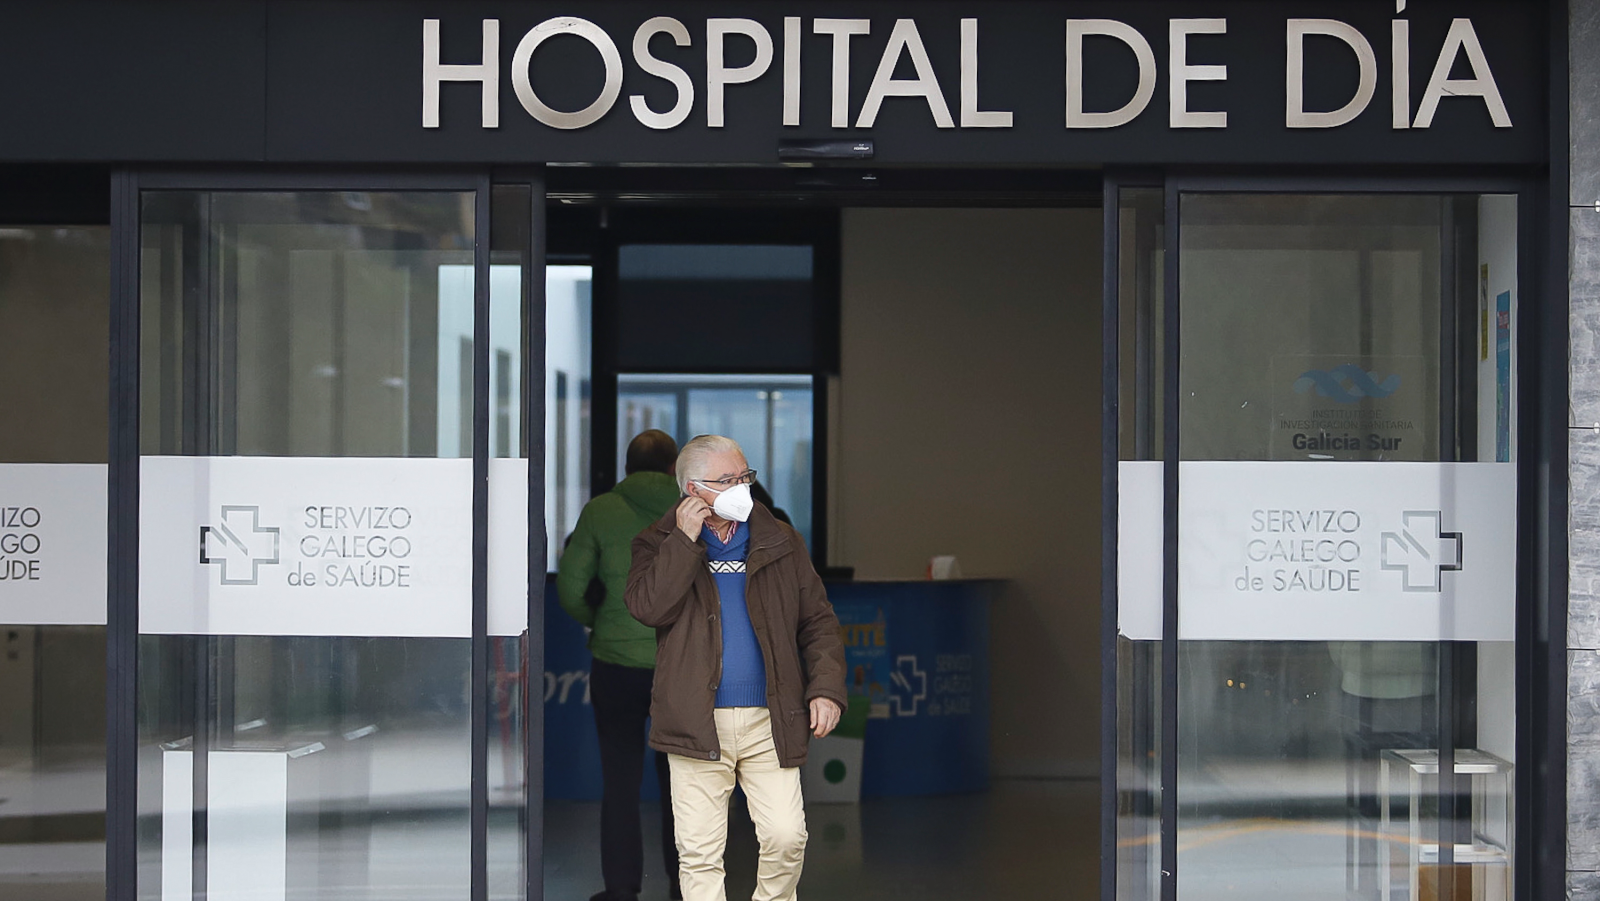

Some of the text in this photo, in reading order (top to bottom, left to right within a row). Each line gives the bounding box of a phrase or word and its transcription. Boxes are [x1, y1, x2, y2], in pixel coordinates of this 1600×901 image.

[422, 0, 1513, 129] HOSPITAL DE DÍA
[1292, 432, 1403, 451] Galicia Sur
[304, 506, 411, 530] SERVIZO
[1251, 509, 1361, 533] SERVIZO
[300, 535, 411, 559] GALEGO
[1247, 539, 1361, 563] GALEGO
[287, 560, 410, 588] de SAÚDE
[1234, 565, 1264, 592] de
